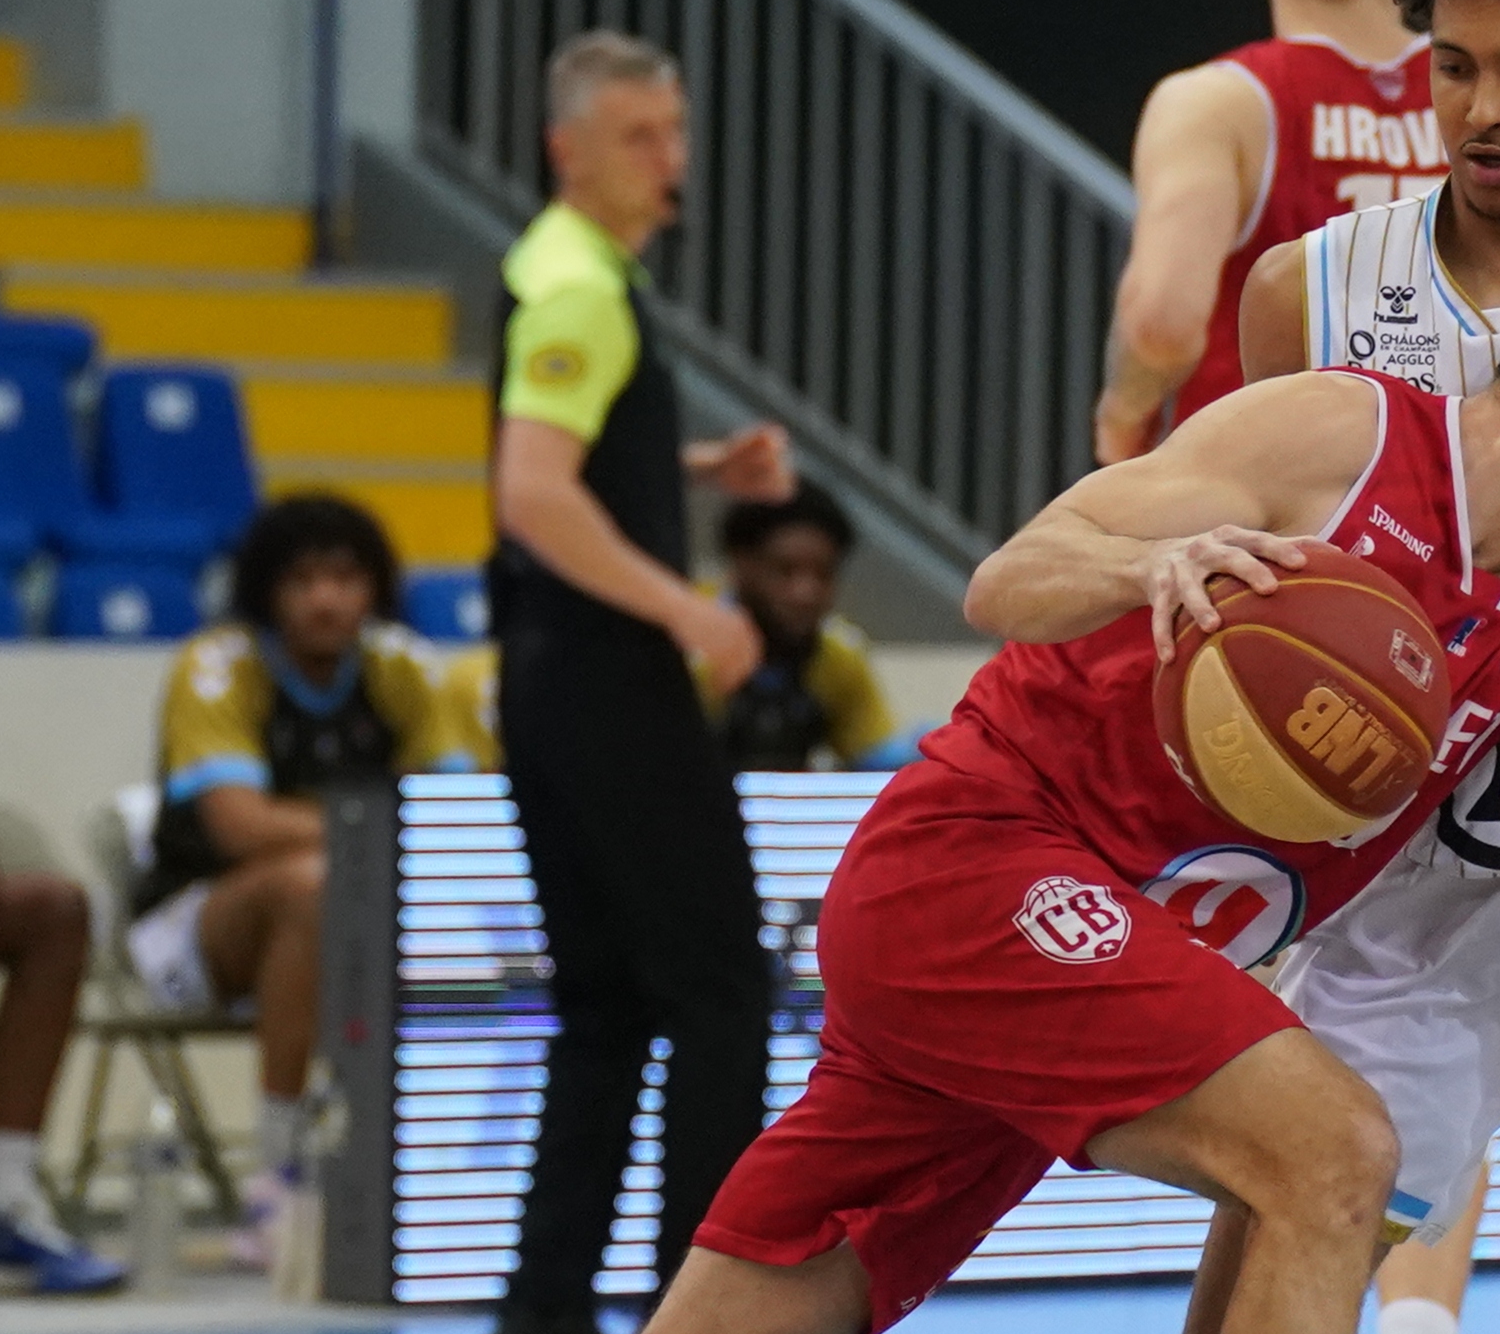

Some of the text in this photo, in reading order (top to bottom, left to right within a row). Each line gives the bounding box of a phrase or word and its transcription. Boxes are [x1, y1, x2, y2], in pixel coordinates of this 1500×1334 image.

[1313, 103, 1450, 168] HROV
[1374, 312, 1418, 324] hummel
[1380, 331, 1440, 345] CHÂLONS
[1387, 354, 1435, 365] AGGLO
[1368, 504, 1435, 563] SPALDING
[1286, 686, 1402, 794] LNB
[1036, 890, 1120, 953] CB
